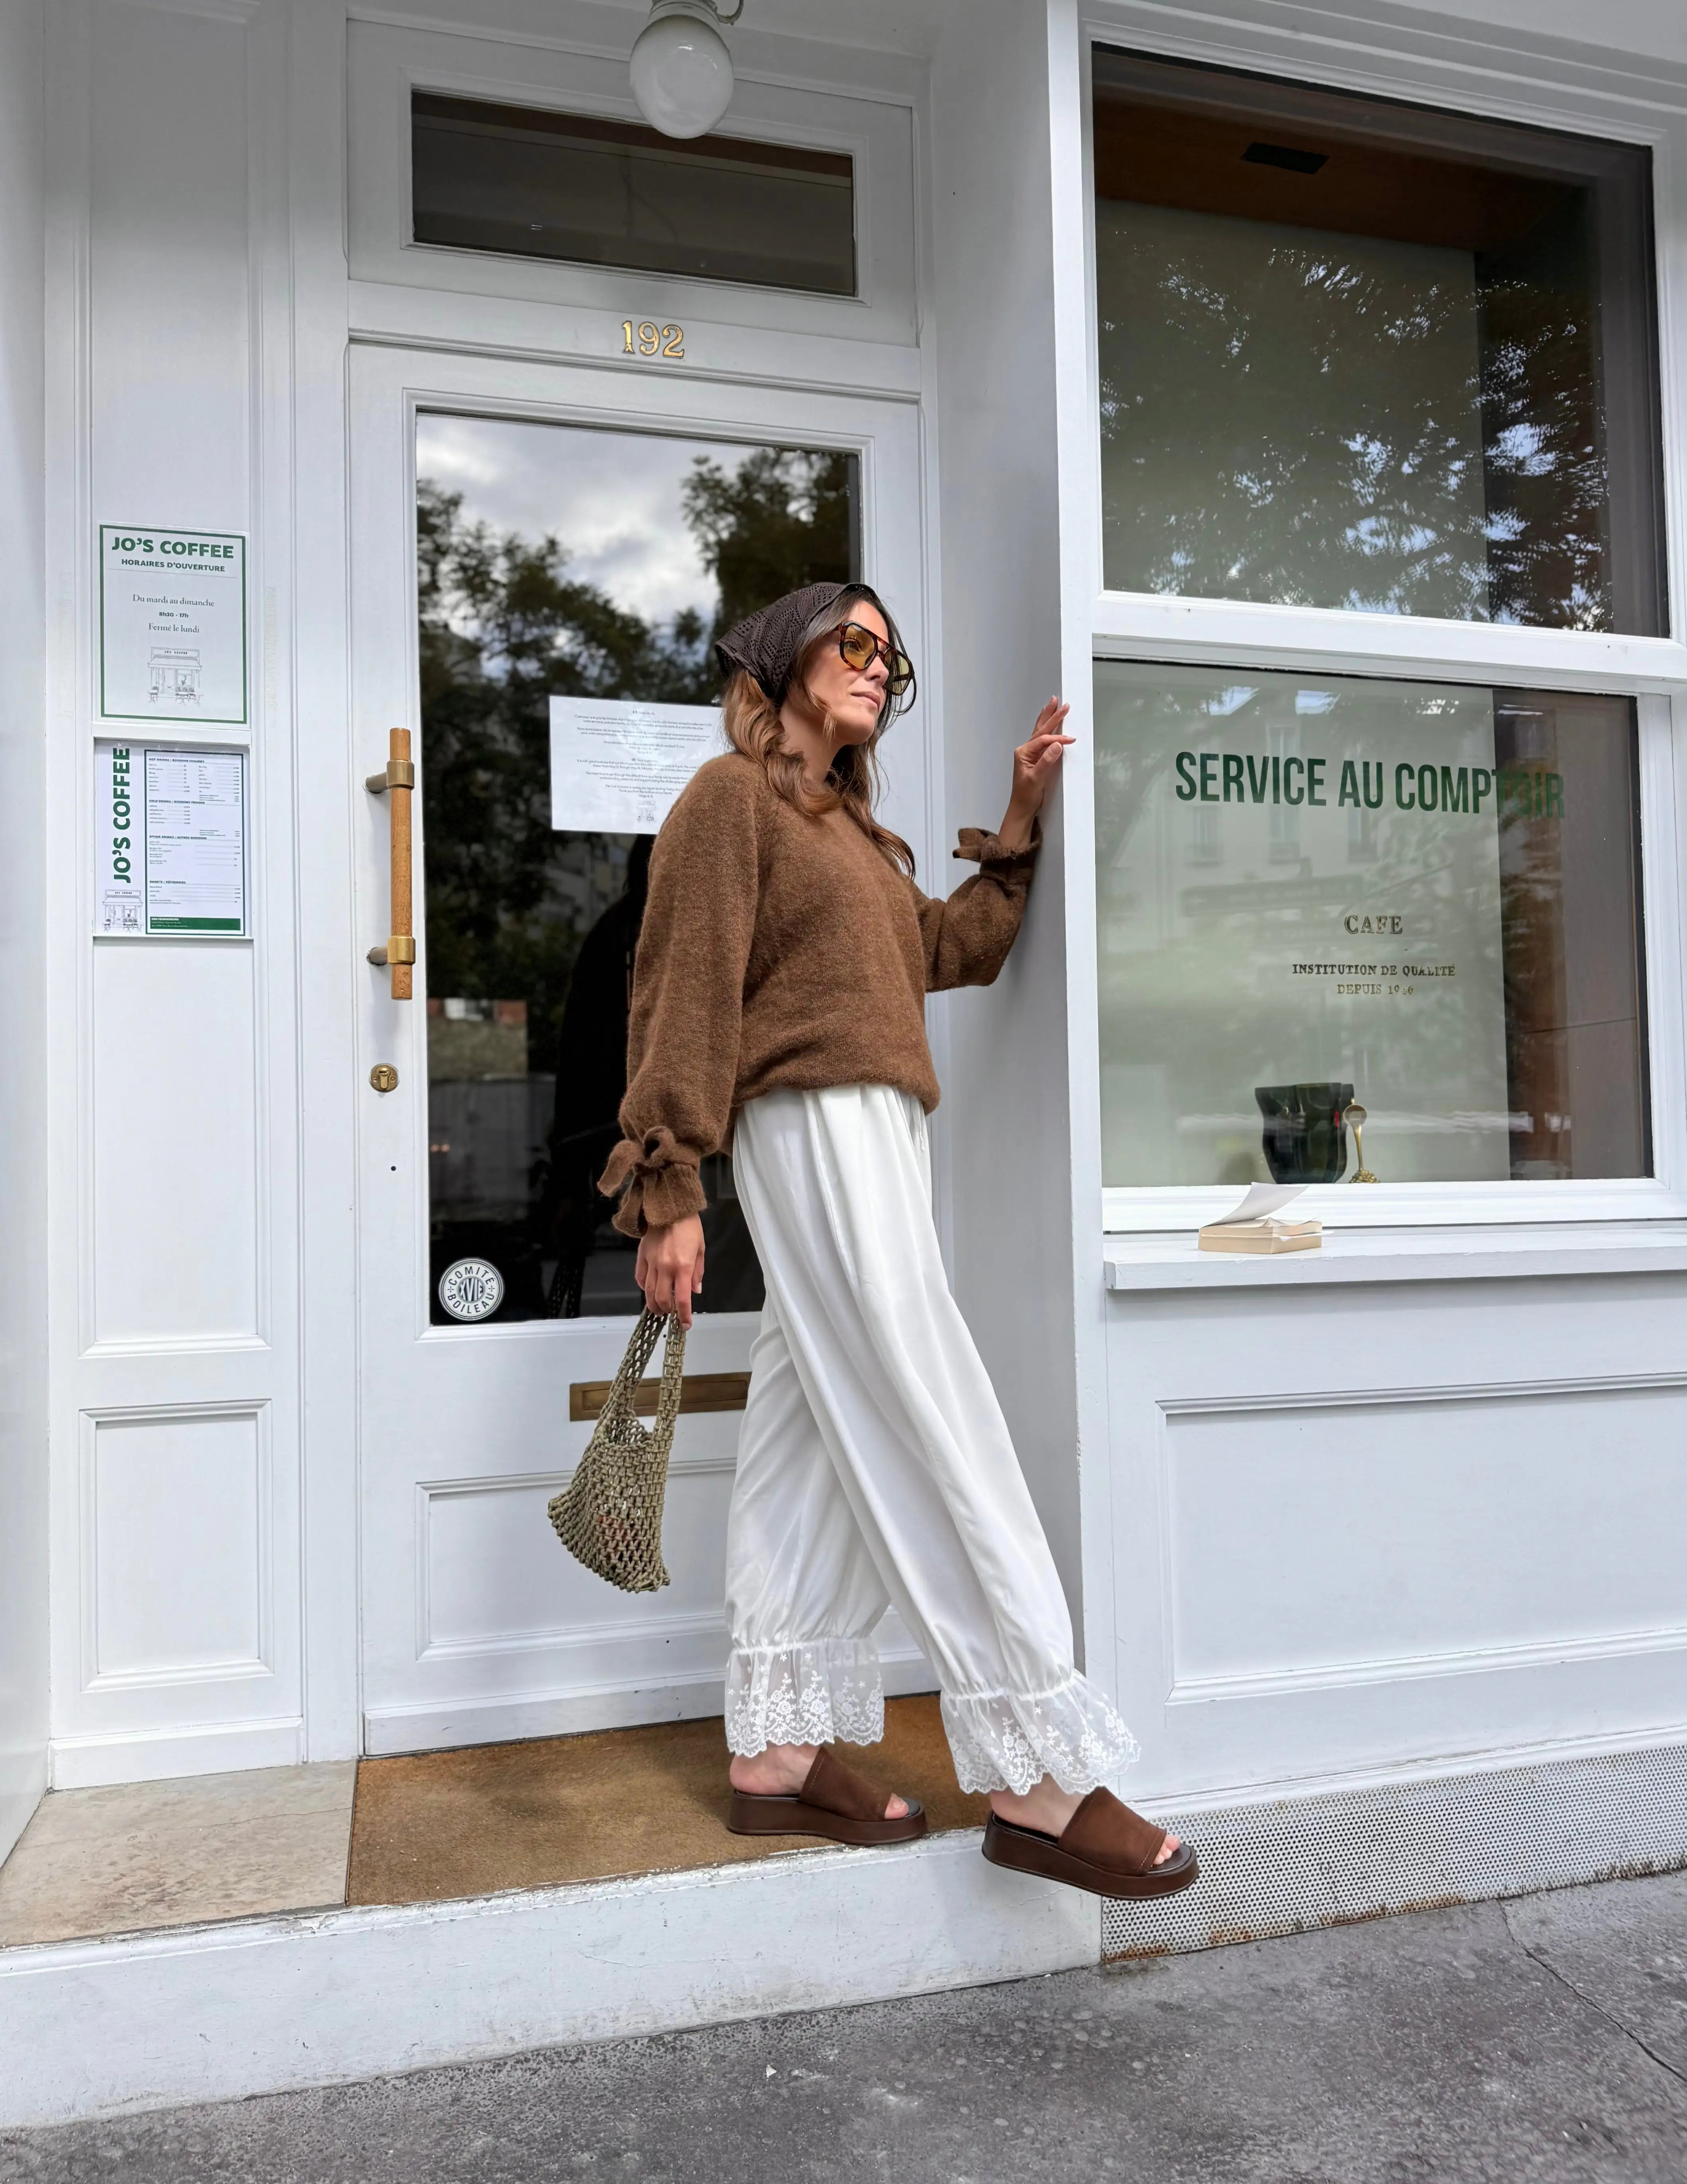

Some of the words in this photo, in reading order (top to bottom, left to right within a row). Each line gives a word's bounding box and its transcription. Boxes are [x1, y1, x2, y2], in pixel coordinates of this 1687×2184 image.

[622, 320, 684, 358] 192
[112, 537, 154, 553] JO’S
[160, 540, 234, 559] COFFEE
[121, 559, 164, 567] HORAIRES
[167, 562, 225, 572] D’OUVERTURE
[180, 597, 215, 607] dimanche
[148, 623, 172, 631] Fermé
[181, 625, 200, 633] lundi
[113, 747, 131, 830] COFFEE
[1175, 751, 1327, 807] SERVICE
[1338, 760, 1384, 809] AU
[1395, 763, 1565, 819] COMPTOIR
[112, 836, 131, 883] JO’S
[1344, 915, 1403, 934] CAFE
[1292, 964, 1377, 975] INSTITUTION
[1380, 965, 1397, 976] DE
[1337, 984, 1382, 994] DEPUIS
[448, 1266, 496, 1286] COMITÉ
[447, 1293, 495, 1314] BOILEAU
